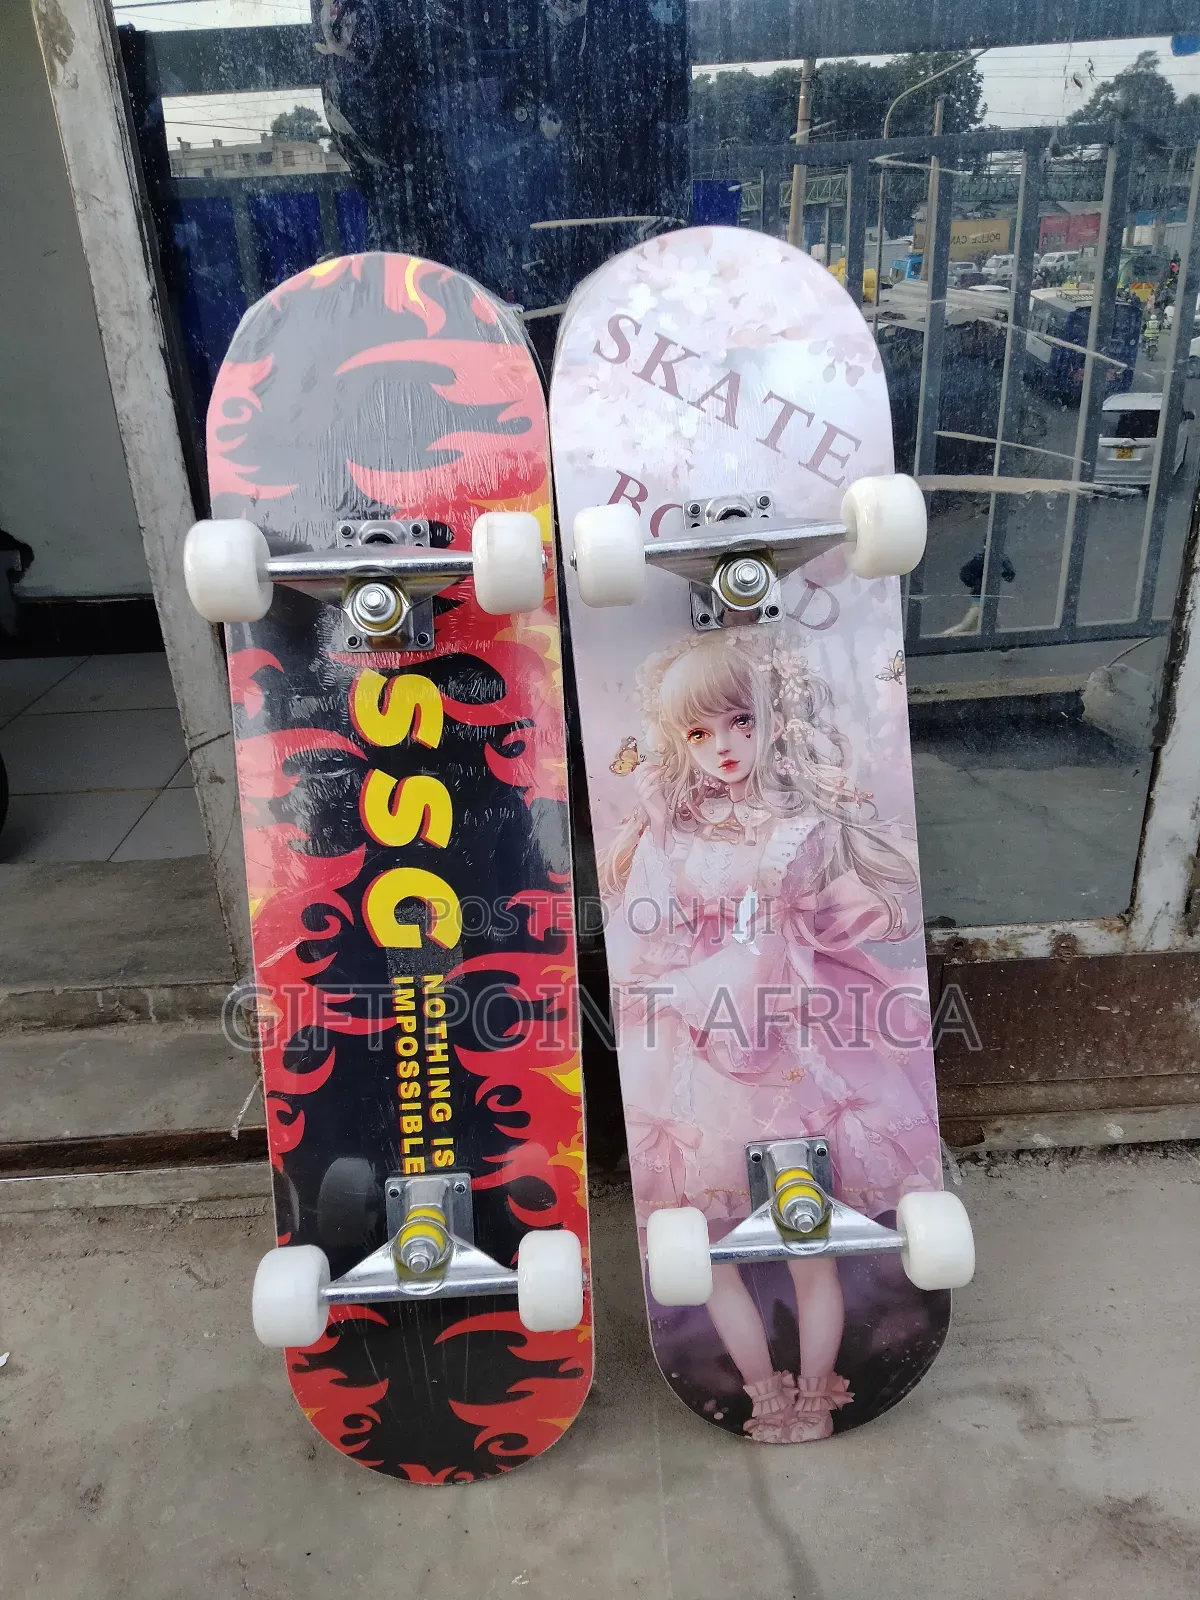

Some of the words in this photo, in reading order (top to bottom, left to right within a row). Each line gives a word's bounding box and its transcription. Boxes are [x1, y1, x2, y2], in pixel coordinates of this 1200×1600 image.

[593, 313, 863, 488] SKATE
[350, 667, 464, 950] SSG
[391, 975, 426, 1176] IMPOSSIBLE
[422, 974, 453, 1123] NOTHING
[430, 1138, 456, 1168] IS
